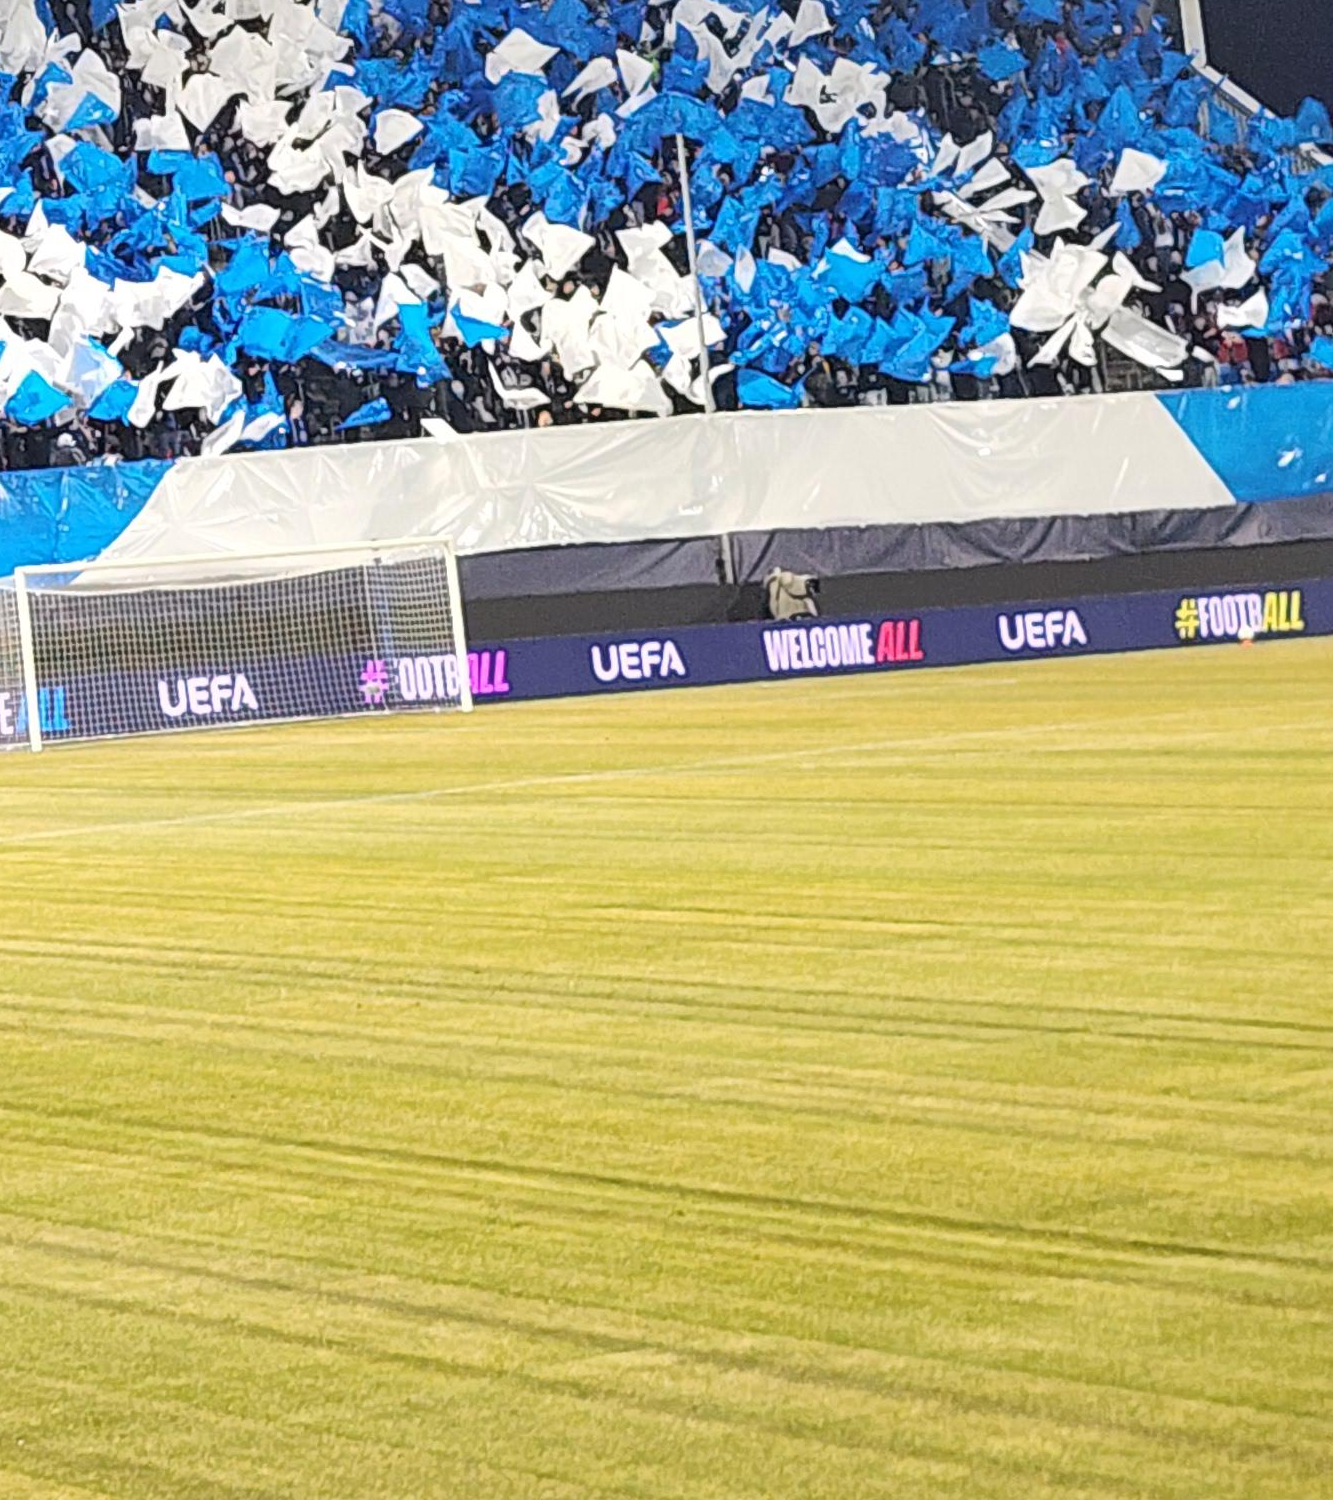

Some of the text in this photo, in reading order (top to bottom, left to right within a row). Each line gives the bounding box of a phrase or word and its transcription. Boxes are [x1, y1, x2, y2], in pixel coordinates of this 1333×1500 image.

[999, 610, 1087, 650] UEFA
[1175, 590, 1305, 639] #FOOTBALL
[591, 641, 686, 681] UEFA
[763, 619, 923, 671] WELCOME ALL
[158, 673, 259, 716] UEFA
